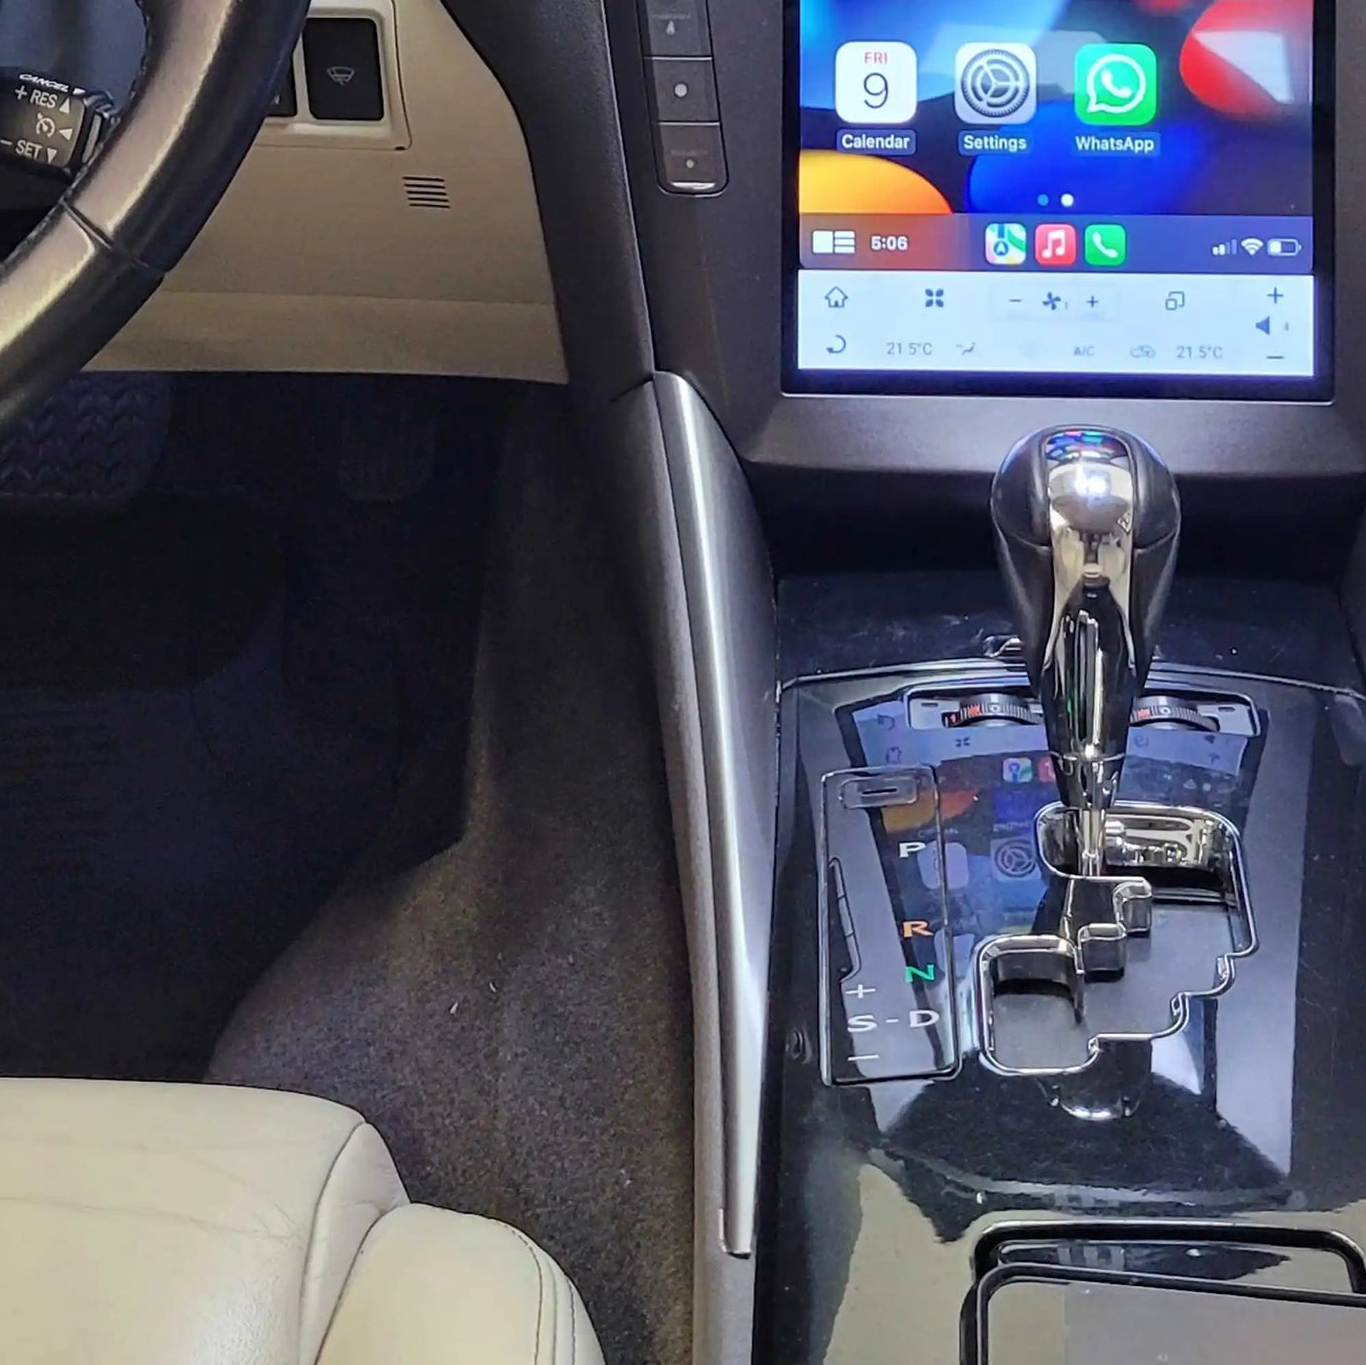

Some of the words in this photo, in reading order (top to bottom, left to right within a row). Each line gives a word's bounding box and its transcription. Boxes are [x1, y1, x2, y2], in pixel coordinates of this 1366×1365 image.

[864, 52, 889, 65] FRI
[29, 89, 57, 109] RES
[863, 72, 890, 109] 9
[15, 139, 43, 159] SET
[841, 135, 910, 151] Calendar
[963, 135, 1028, 153] Settings
[1075, 135, 1155, 154] WhatsApp
[870, 236, 908, 251] 5:06
[886, 342, 933, 356] 215°C
[899, 842, 927, 858] P
[902, 920, 934, 938] R
[904, 964, 935, 983] N
